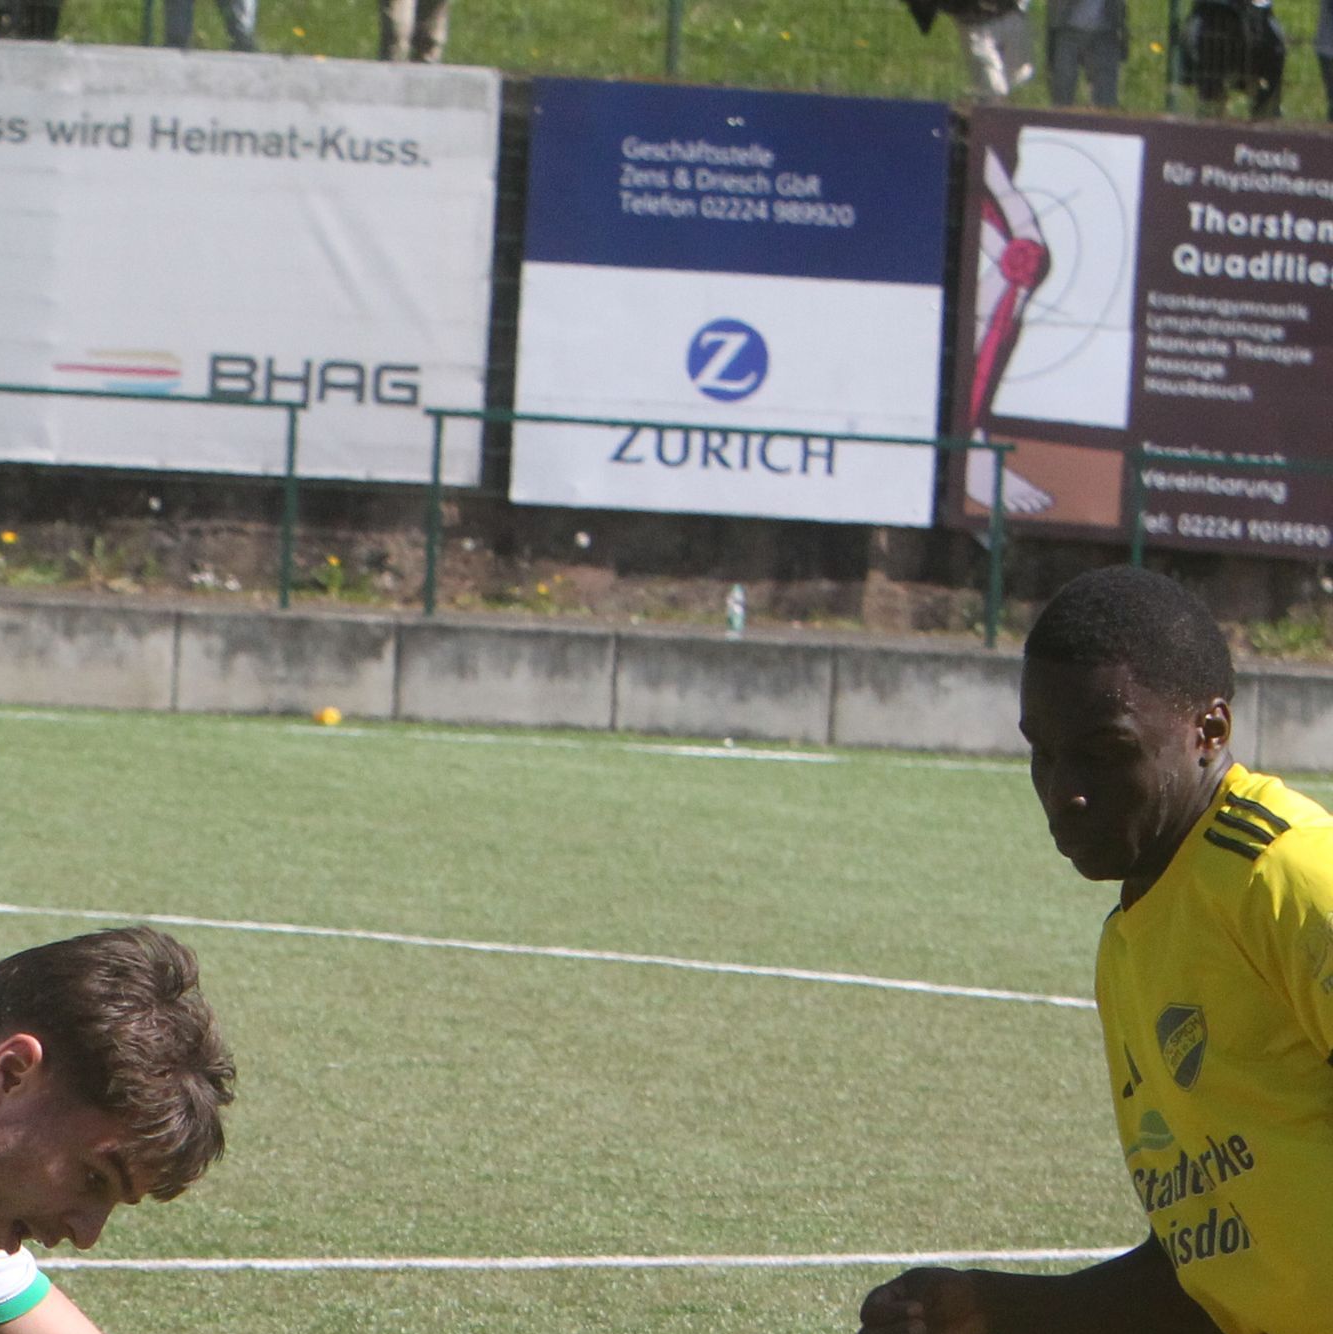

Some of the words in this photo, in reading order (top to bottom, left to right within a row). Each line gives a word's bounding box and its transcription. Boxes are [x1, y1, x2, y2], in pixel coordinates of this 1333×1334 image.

[44, 111, 132, 151] wird
[148, 114, 432, 168] Heimat-Kuss.
[1234, 142, 1301, 172] Praxis
[672, 166, 692, 190] &
[1162, 160, 1197, 187] für
[619, 190, 697, 218] Telefon
[699, 195, 770, 222] 02224
[1188, 201, 1333, 244] Thorsten
[1172, 243, 1333, 291] Quadflie
[1234, 339, 1315, 367] Therapie
[209, 353, 421, 406] BHAG
[610, 426, 834, 475] ZURICH
[1177, 511, 1243, 540] 02224
